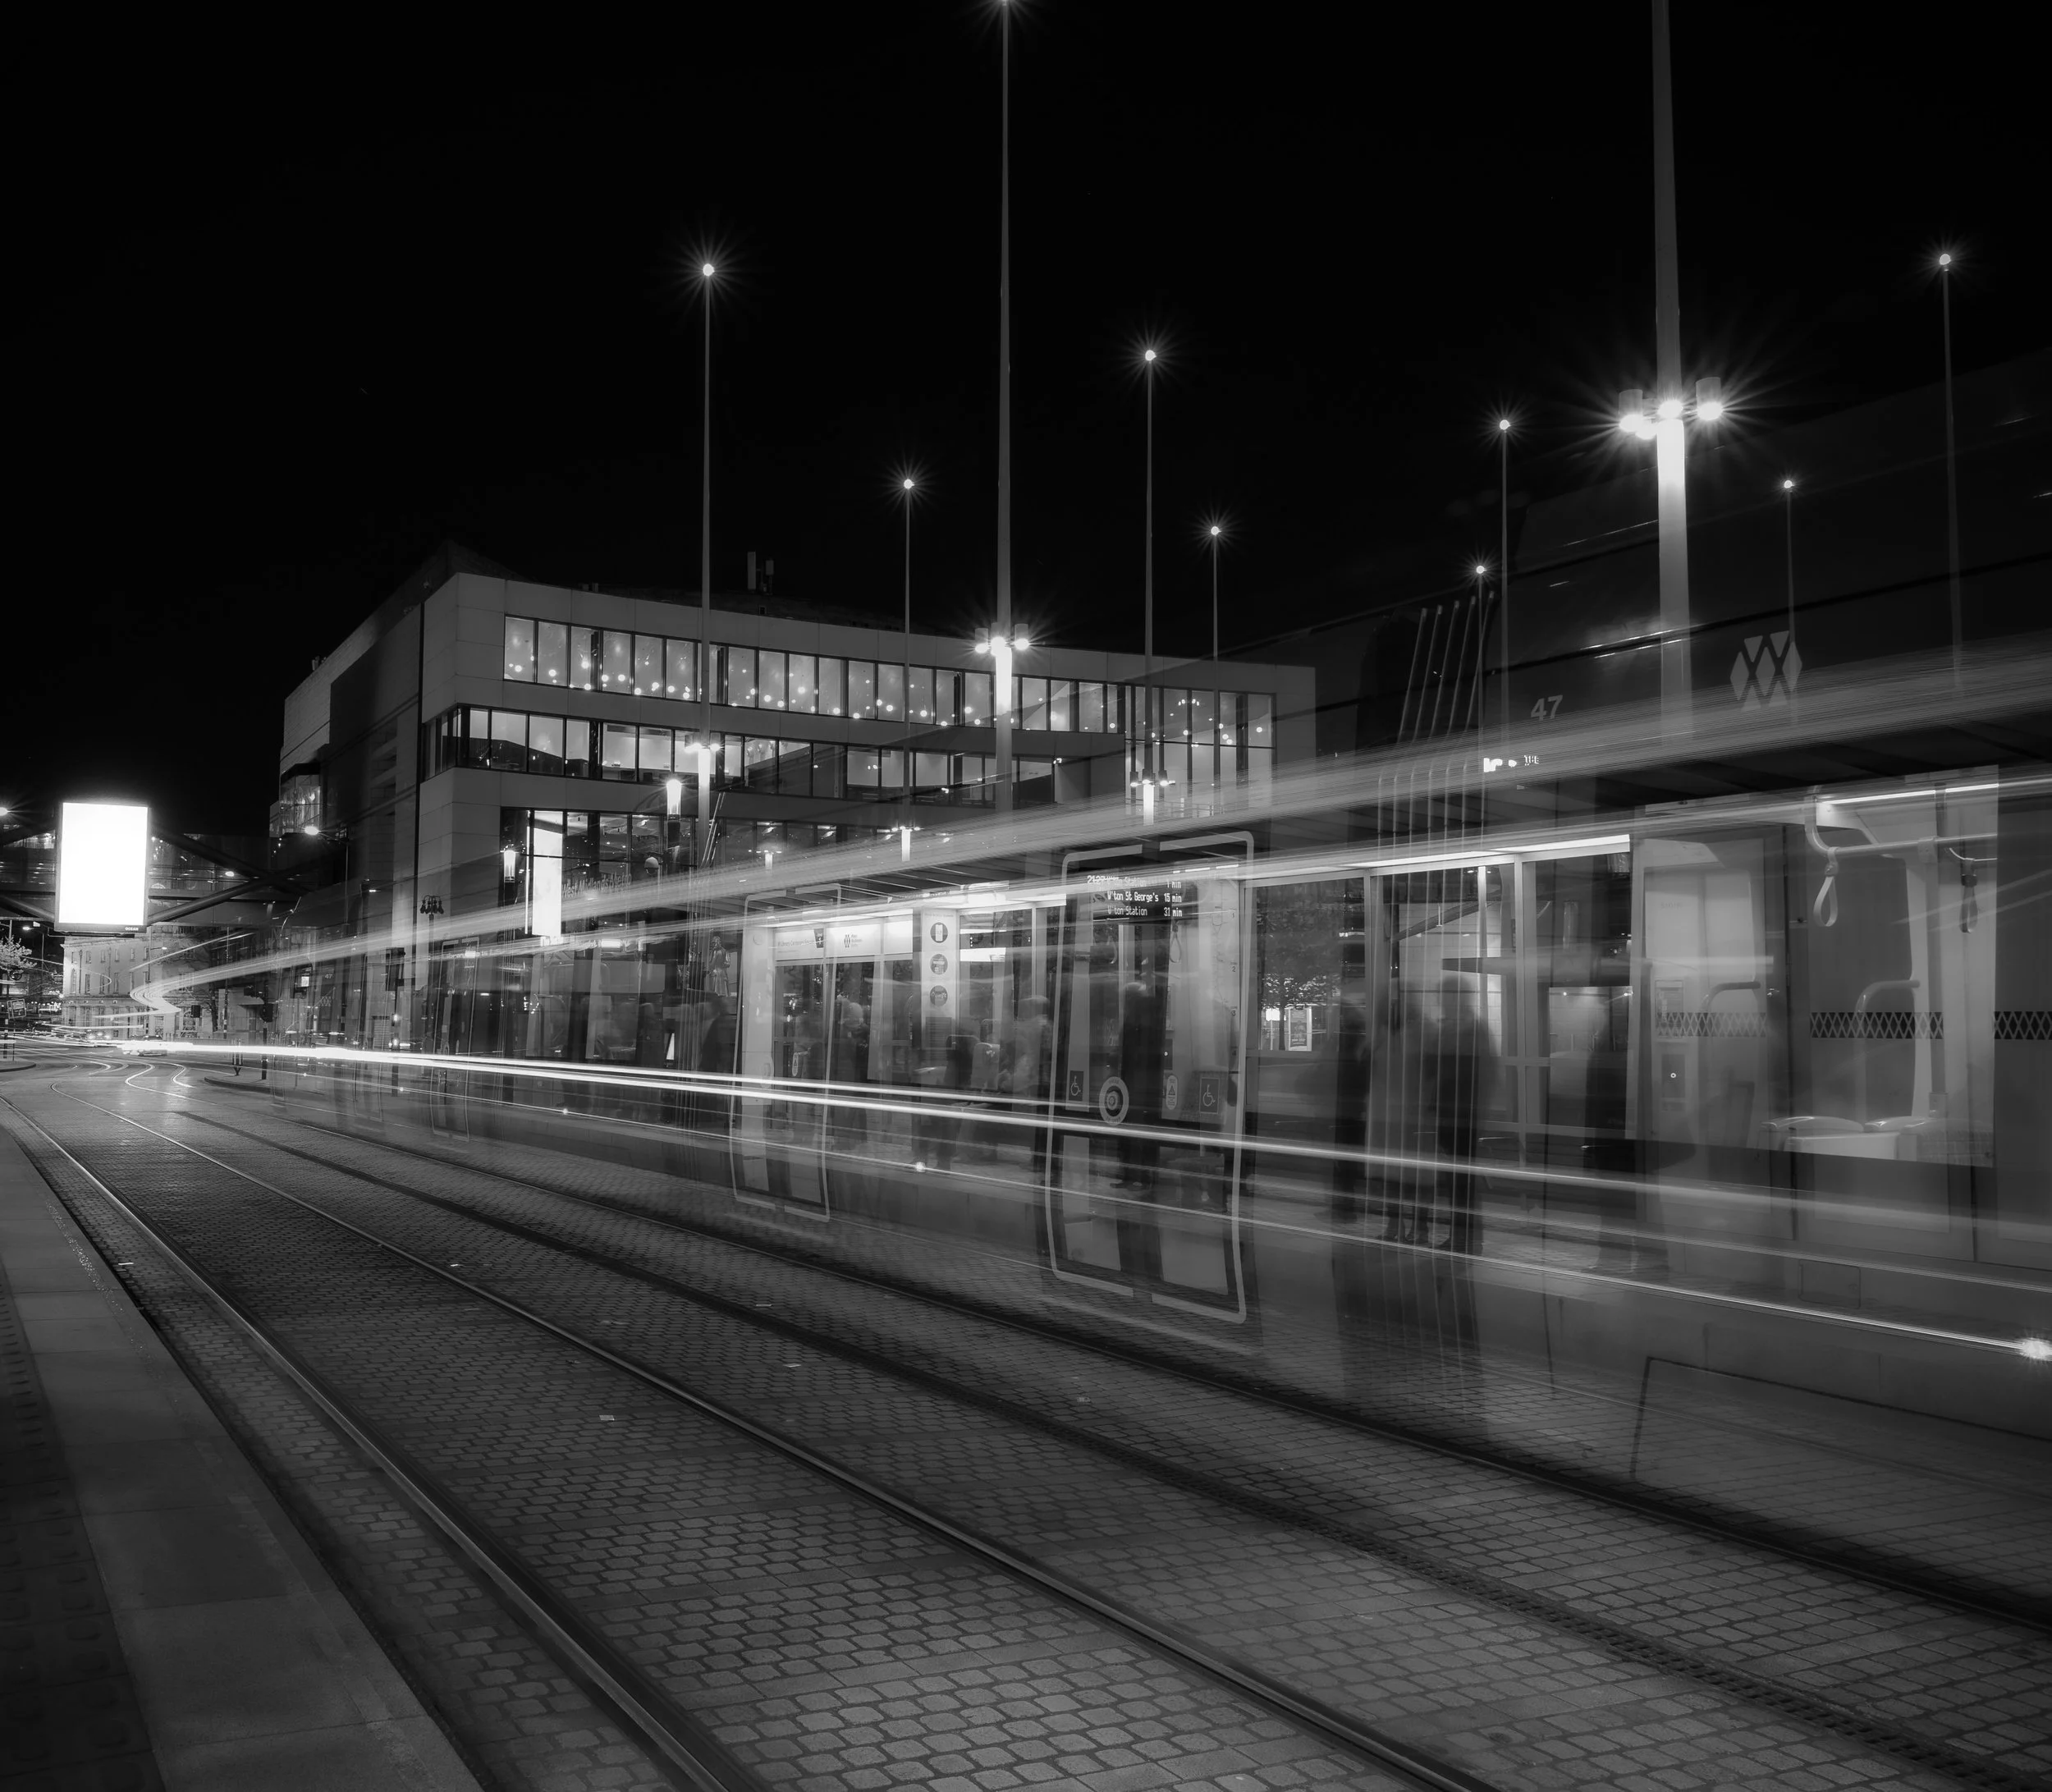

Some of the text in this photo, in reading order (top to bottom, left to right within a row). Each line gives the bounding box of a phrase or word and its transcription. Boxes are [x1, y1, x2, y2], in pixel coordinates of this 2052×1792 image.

[1531, 694, 1564, 722] 47
[1107, 891, 1182, 903] W'ton St George's 15 min
[1125, 906, 1147, 916] Station
[1164, 907, 1170, 917] 31
[1172, 907, 1183, 917] min
